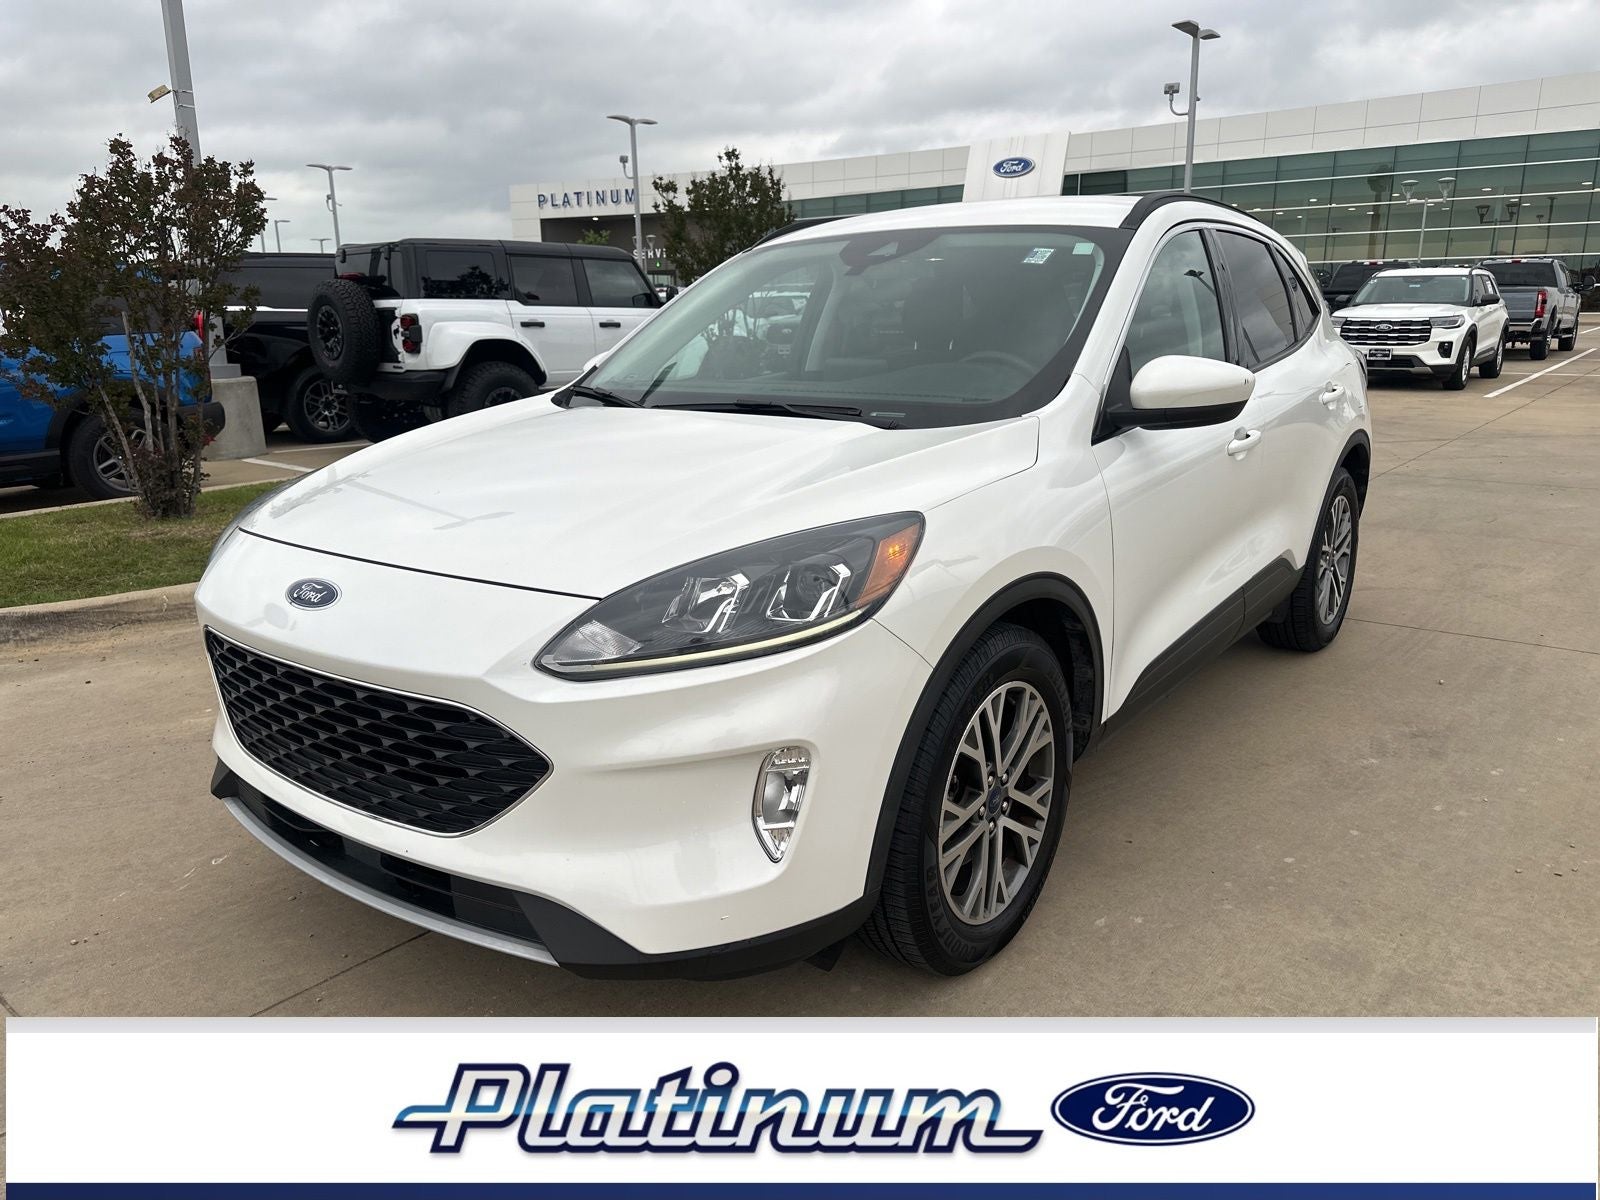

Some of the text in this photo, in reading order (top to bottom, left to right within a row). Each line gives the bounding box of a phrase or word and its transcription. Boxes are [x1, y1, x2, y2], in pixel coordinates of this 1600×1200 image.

[1000, 160, 1024, 173] Ford
[537, 188, 635, 209] PLATINUM
[293, 582, 328, 603] Ford
